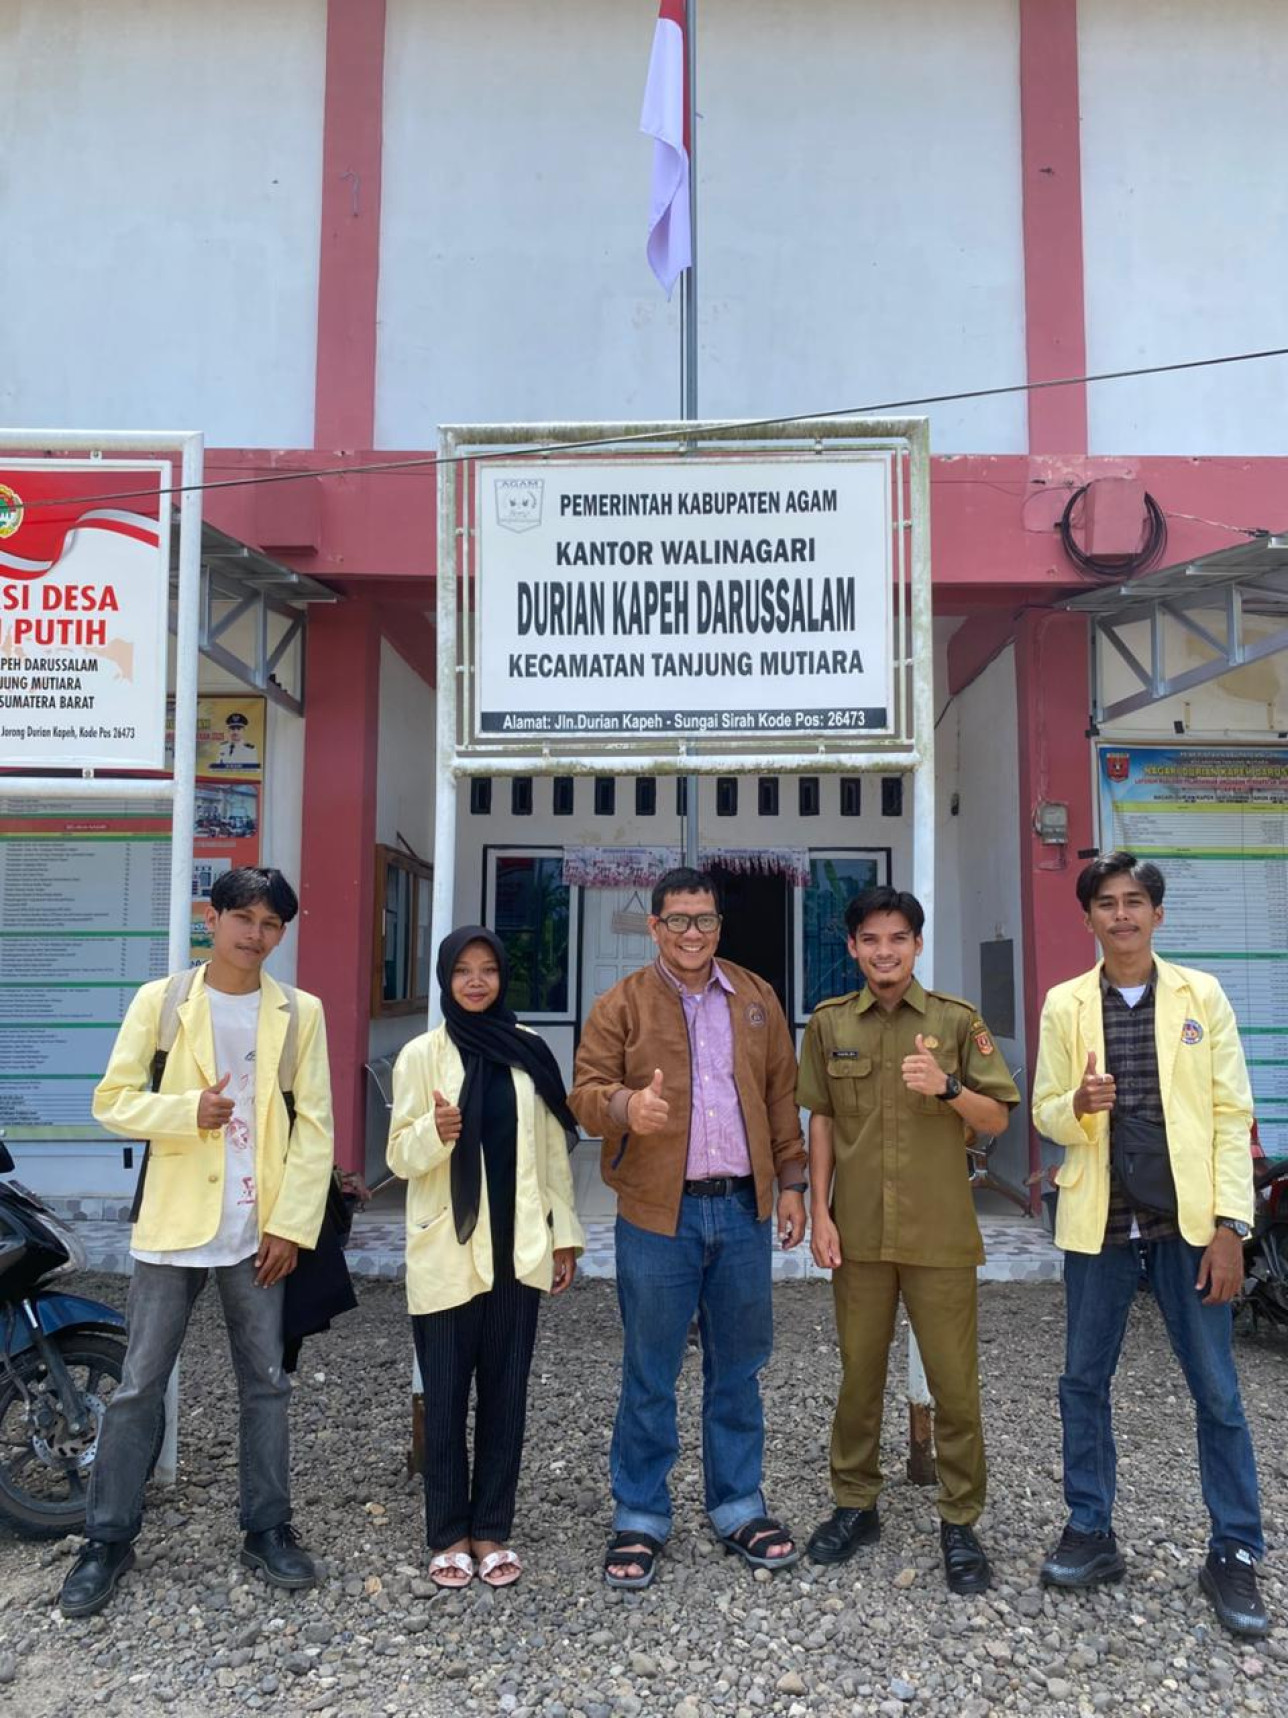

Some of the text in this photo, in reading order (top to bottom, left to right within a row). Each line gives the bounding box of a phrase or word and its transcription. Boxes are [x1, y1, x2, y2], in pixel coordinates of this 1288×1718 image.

[560, 489, 838, 516] PEMERINTAH KABUPATEN AGAM
[556, 537, 816, 566] KANTOR WALINAGARI
[2, 584, 119, 611] SI DESA
[517, 576, 856, 636] DURIAN KAPEH DARUSSALAM
[14, 619, 106, 645] PUTIH
[0, 658, 98, 672] PEH DARUSSALAM
[509, 649, 864, 678] KECAMATAN TANJUNG MUTIARA
[31, 676, 82, 691] MUTIARA
[0, 695, 95, 709] SUMATERA BARAT
[1, 725, 135, 740] Jorong Durian Kapeh, Kode Pos 26473
[502, 714, 551, 730] Alamat:
[622, 713, 663, 731] Kapeh
[674, 713, 719, 731] Sungai
[722, 712, 755, 728] Sirah
[758, 712, 792, 727] Kode
[795, 712, 824, 727] Pos:
[827, 710, 865, 726] 26473
